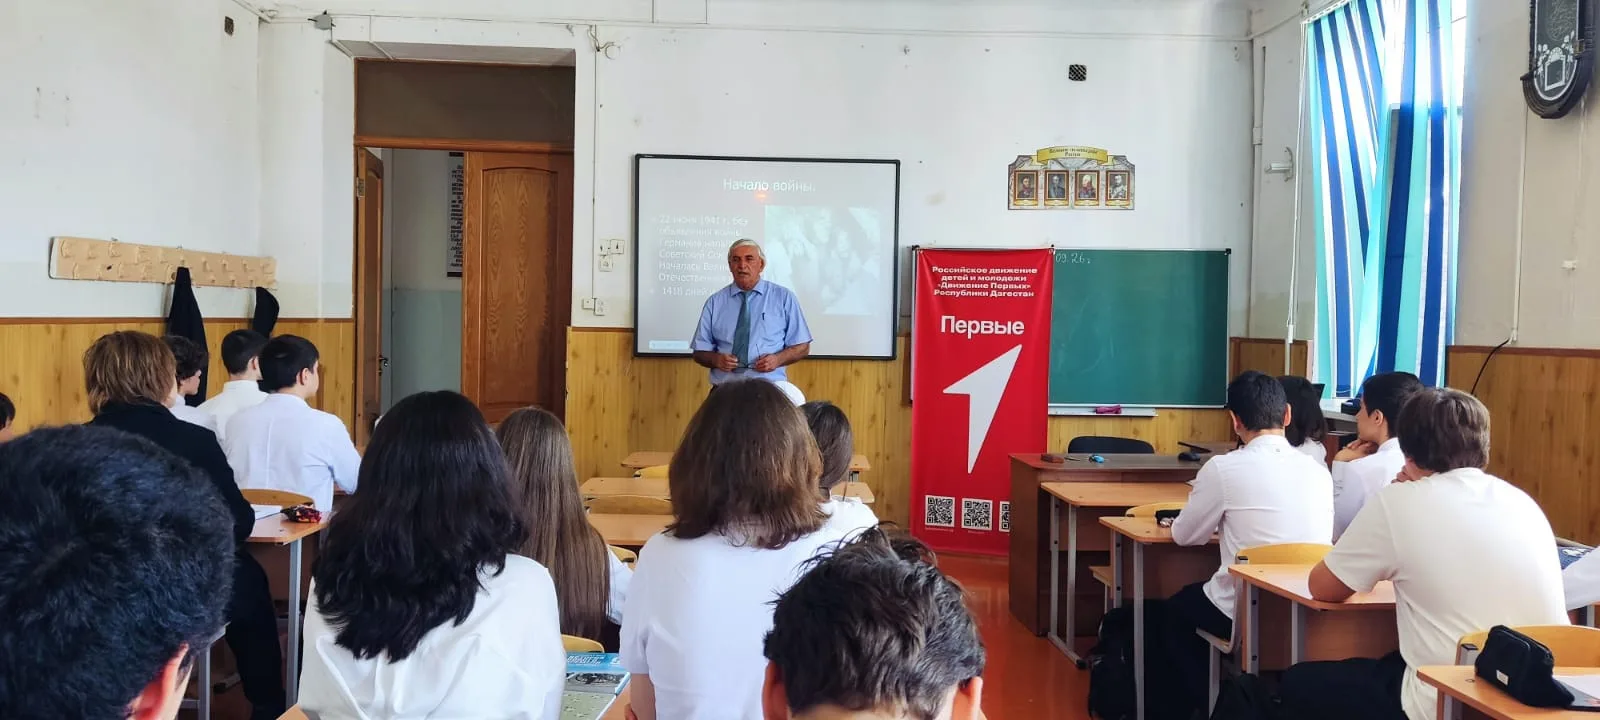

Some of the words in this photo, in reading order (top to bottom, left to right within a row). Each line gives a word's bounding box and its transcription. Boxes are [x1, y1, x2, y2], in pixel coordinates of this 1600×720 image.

[722, 177, 769, 191] Начало
[773, 179, 816, 192] войны.
[659, 249, 705, 260] Советский
[659, 261, 700, 271] Началась
[932, 266, 987, 274] Российское
[989, 267, 1038, 275] движение
[941, 274, 969, 282] детей
[938, 281, 989, 289] «Движение
[990, 282, 1031, 290] Первых»
[934, 289, 988, 298] Республики
[989, 290, 1034, 298] Дагестан
[940, 315, 1025, 339] Первые
